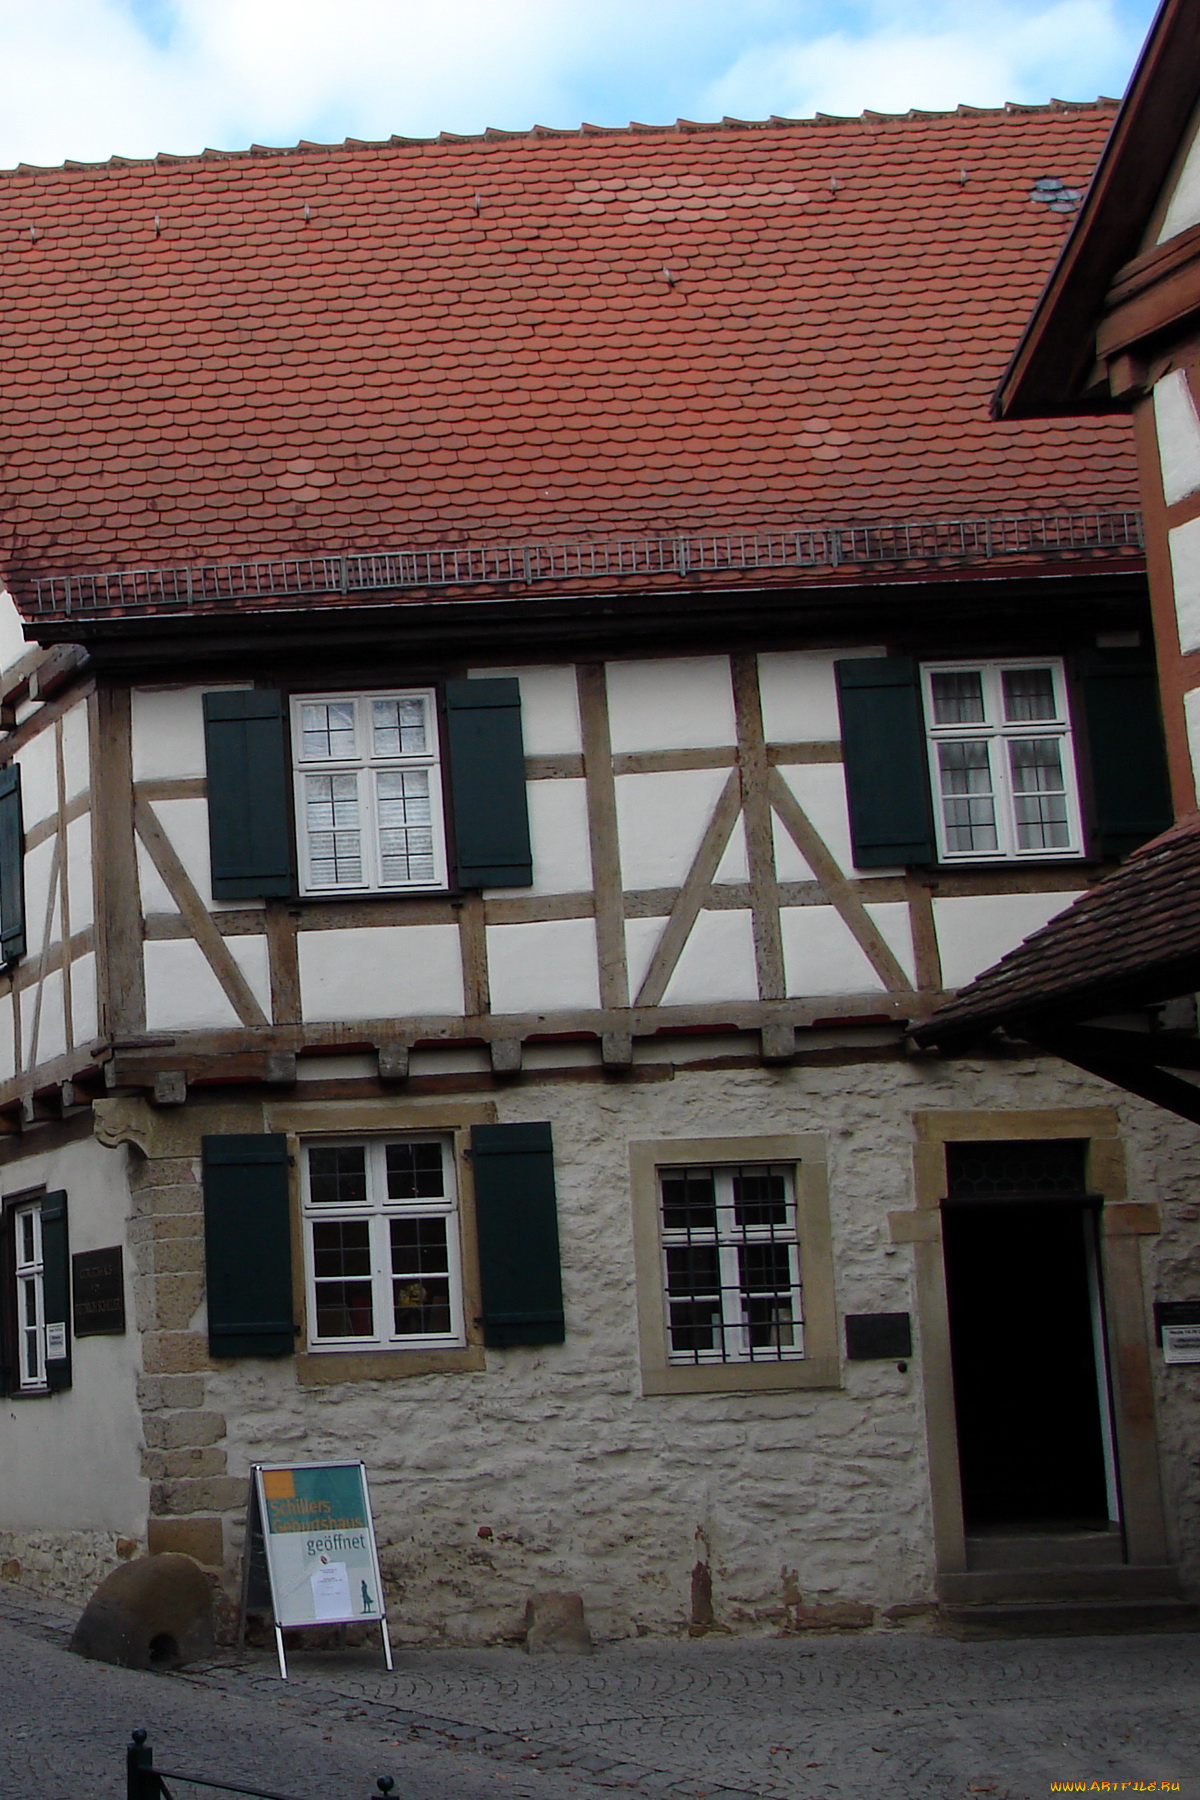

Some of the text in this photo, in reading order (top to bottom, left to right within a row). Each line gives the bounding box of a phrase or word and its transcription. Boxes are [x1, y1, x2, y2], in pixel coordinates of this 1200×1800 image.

[269, 1498, 331, 1517] Schillers
[272, 1515, 363, 1534] Geburtshaus
[307, 1533, 367, 1556] geöffnet
